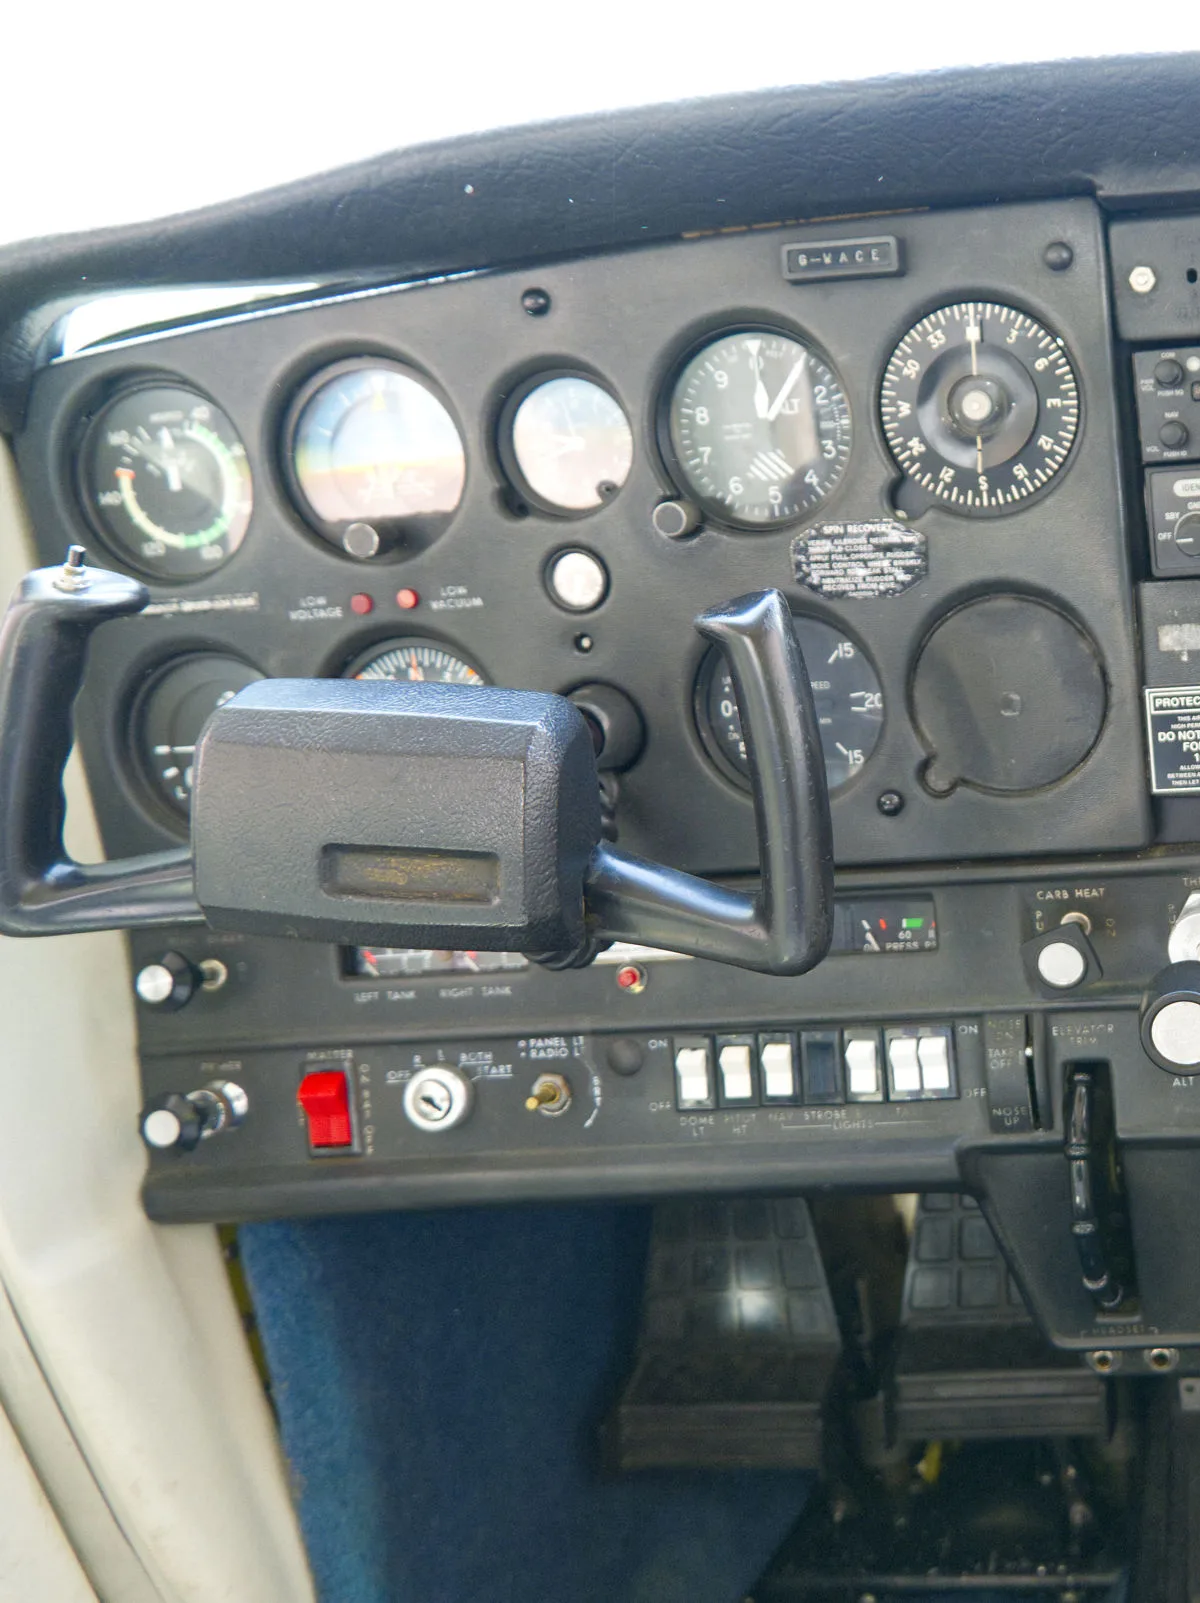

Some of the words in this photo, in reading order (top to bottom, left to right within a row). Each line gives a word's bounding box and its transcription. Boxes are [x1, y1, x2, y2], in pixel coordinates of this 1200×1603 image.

[798, 248, 880, 266] G-WACE
[926, 329, 946, 349] 33
[1006, 328, 1019, 344] 3
[902, 359, 921, 380] 30
[1034, 357, 1049, 372] 6
[714, 370, 729, 389] 9
[814, 385, 829, 404] 2
[897, 400, 912, 418] W
[1046, 398, 1061, 408] E
[695, 406, 710, 425] 8
[821, 439, 837, 459] 3
[906, 436, 927, 457] 24
[1037, 434, 1055, 451] 12
[698, 446, 712, 464] 7
[804, 468, 819, 485] 4
[938, 465, 956, 483] 21
[1012, 463, 1029, 480] 15
[729, 476, 744, 495] 6
[978, 475, 989, 490] S
[768, 485, 783, 504] 5
[1164, 512, 1181, 521] SBY
[822, 525, 845, 536] SPIN
[846, 523, 894, 535] RECOVERY
[1157, 532, 1172, 541] OFF
[430, 597, 484, 611] VACUUM
[289, 606, 344, 621] VOLTAGE
[838, 642, 855, 658] 15
[721, 701, 732, 717] 0
[1158, 731, 1176, 742] DO
[847, 749, 865, 764] 15
[1036, 889, 1069, 900] CARB
[1074, 887, 1106, 898] HEAT
[898, 930, 912, 940] 60
[885, 941, 919, 952] PRESS
[387, 989, 417, 1000] TANK
[439, 986, 474, 998] RIGHT
[481, 985, 512, 997] TANK
[958, 1024, 979, 1035] ON
[1051, 1023, 1115, 1036] ELEVATOR
[528, 1037, 567, 1048] PANEL
[572, 1035, 585, 1046] LT
[648, 1038, 669, 1049] ON
[437, 1049, 446, 1061] L
[460, 1051, 493, 1062] BOTH
[529, 1046, 569, 1059] RADIO
[386, 1069, 411, 1081] OFF
[476, 1063, 513, 1075] START
[1172, 1076, 1195, 1087] ALT
[965, 1087, 988, 1098] OFF
[649, 1101, 671, 1112] OFF
[992, 1105, 1029, 1118] NOSE
[680, 1115, 715, 1127] DOME
[803, 1110, 848, 1121] STROBE
[1004, 1116, 1020, 1126] UP
[832, 1120, 875, 1131] LIGHTS
